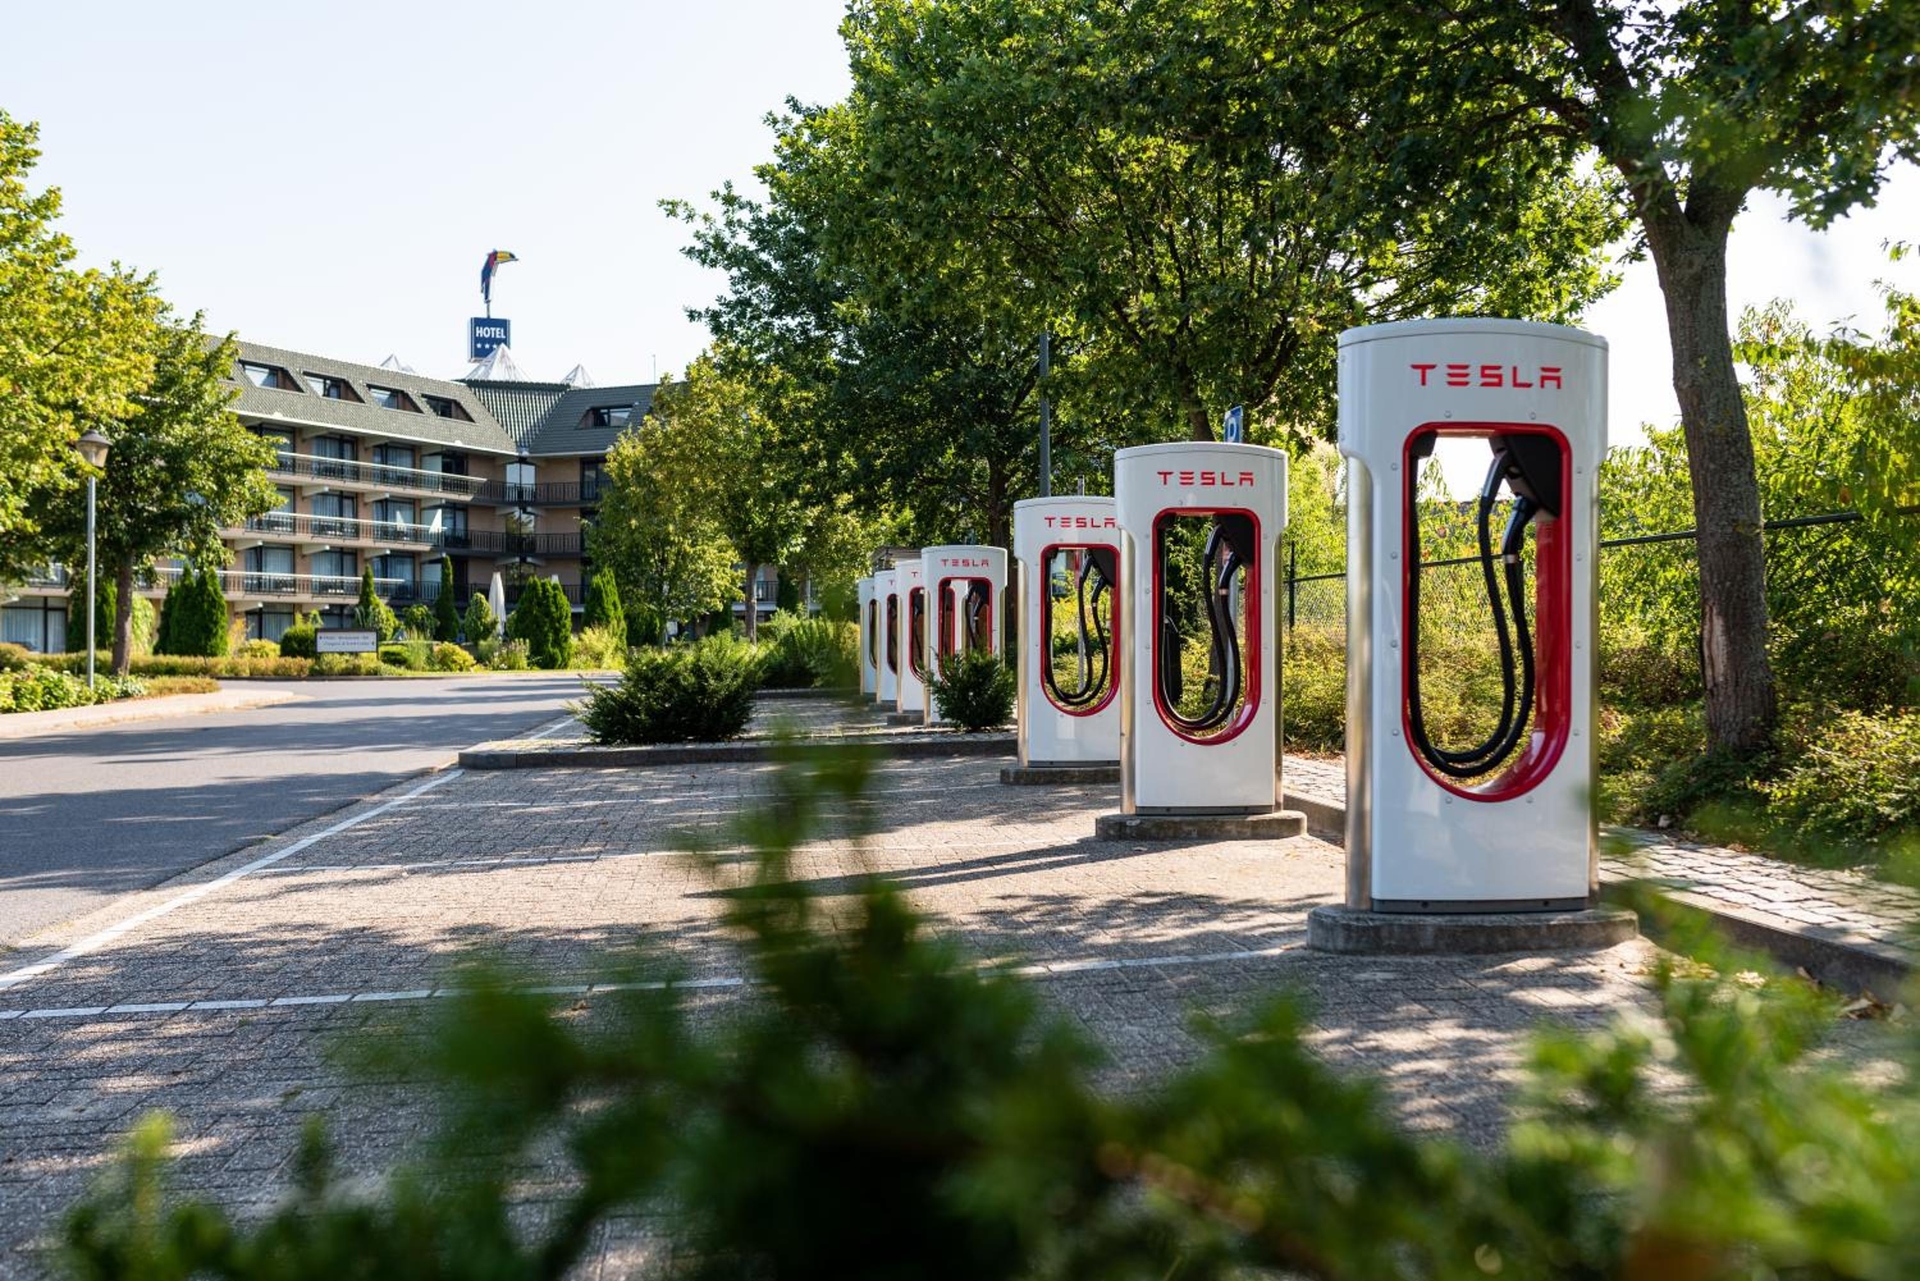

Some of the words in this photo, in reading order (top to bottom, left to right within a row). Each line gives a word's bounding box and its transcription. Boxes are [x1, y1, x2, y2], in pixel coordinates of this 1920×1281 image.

[476, 326, 506, 339] HOTEL
[1410, 364, 1562, 389] TESLA
[1157, 471, 1253, 486] TESLA
[1044, 516, 1116, 528] TESLA
[941, 558, 989, 567] TESLA
